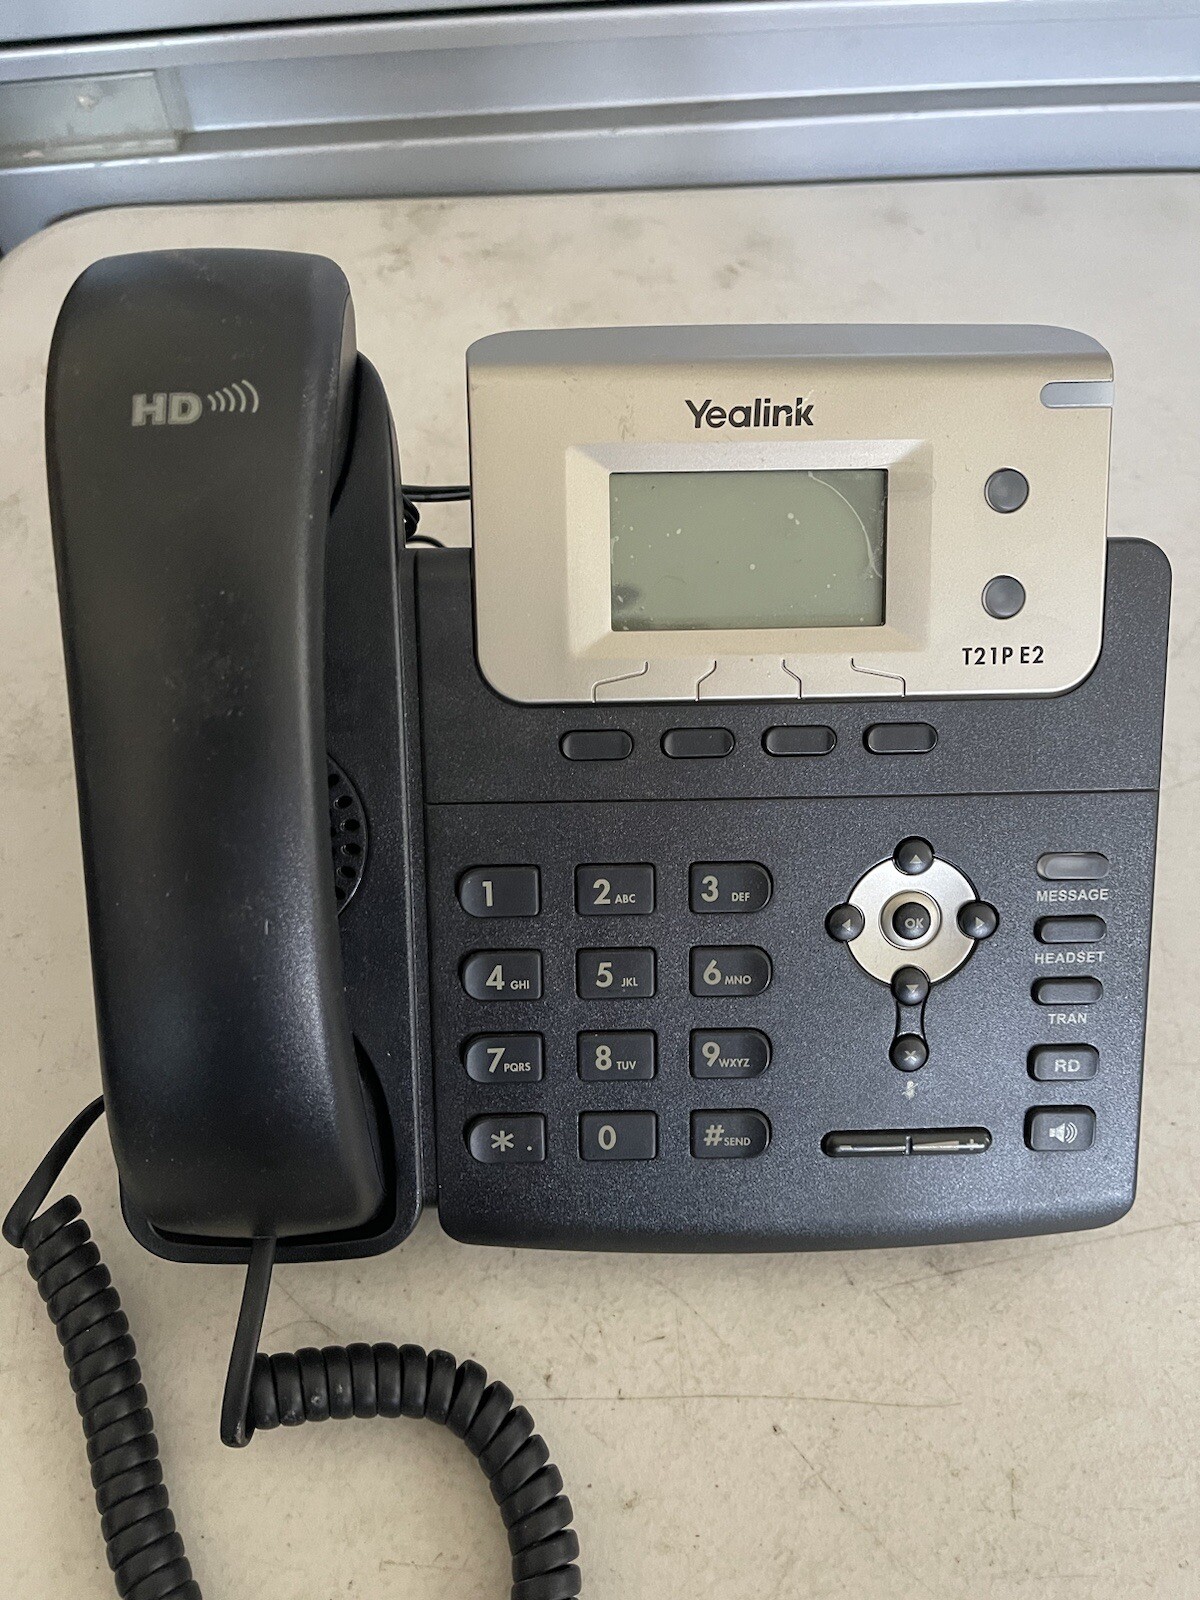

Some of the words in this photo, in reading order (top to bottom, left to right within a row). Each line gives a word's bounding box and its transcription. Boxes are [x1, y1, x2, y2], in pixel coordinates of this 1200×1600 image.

[131, 392, 203, 427] HD
[684, 397, 815, 429] Yealink
[962, 646, 1014, 665] T21P
[1020, 645, 1044, 664] E2
[482, 880, 493, 907] 1
[593, 878, 611, 905] 2
[614, 893, 636, 904] ABC
[701, 875, 719, 902] 3
[731, 892, 751, 902] DEF
[1036, 888, 1109, 903] MESSAGE
[904, 917, 924, 929] OK
[1034, 951, 1106, 965] HEADSET
[485, 964, 505, 990] 4
[509, 980, 530, 990] GHI
[595, 961, 613, 988] 5
[621, 977, 638, 988] JKL
[703, 959, 722, 985] 6
[724, 974, 752, 985] MNO
[1048, 1013, 1088, 1025] TRAN
[486, 1047, 506, 1073] 7
[503, 1061, 531, 1073] PQRS
[595, 1045, 612, 1071] 8
[616, 1060, 637, 1070] TUV
[701, 1041, 721, 1067] 9
[718, 1057, 751, 1068] WXYZ
[1054, 1058, 1081, 1073] RD
[598, 1124, 617, 1151] 0
[723, 1136, 751, 1147] SEND
